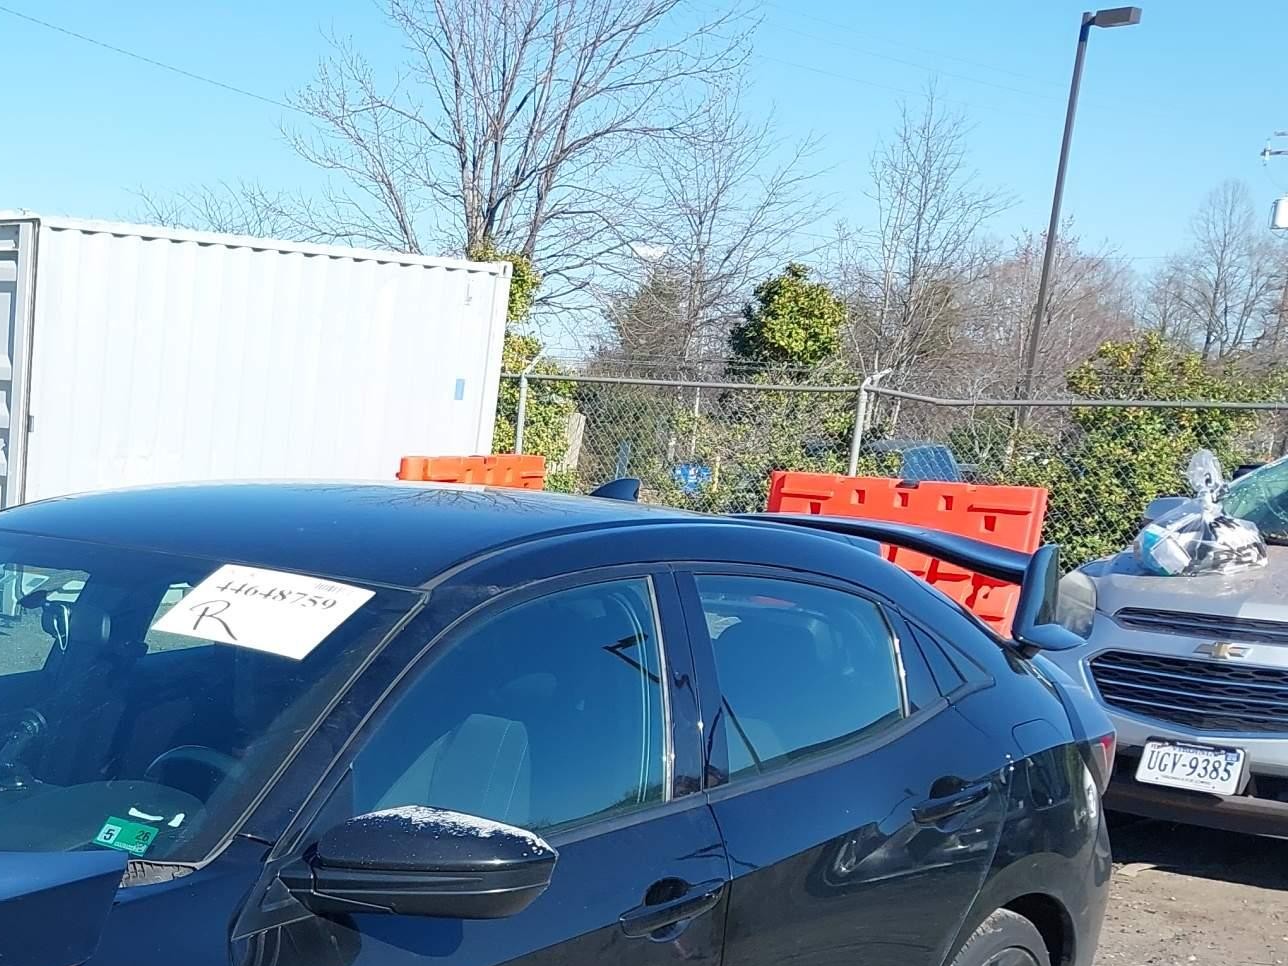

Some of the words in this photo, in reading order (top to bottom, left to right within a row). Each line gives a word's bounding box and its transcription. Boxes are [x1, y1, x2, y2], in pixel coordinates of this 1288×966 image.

[216, 580, 337, 610] 44648759
[189, 599, 238, 641] R
[1147, 750, 1232, 782] UGV-9385
[103, 829, 115, 841] 5
[136, 830, 151, 842] 26
